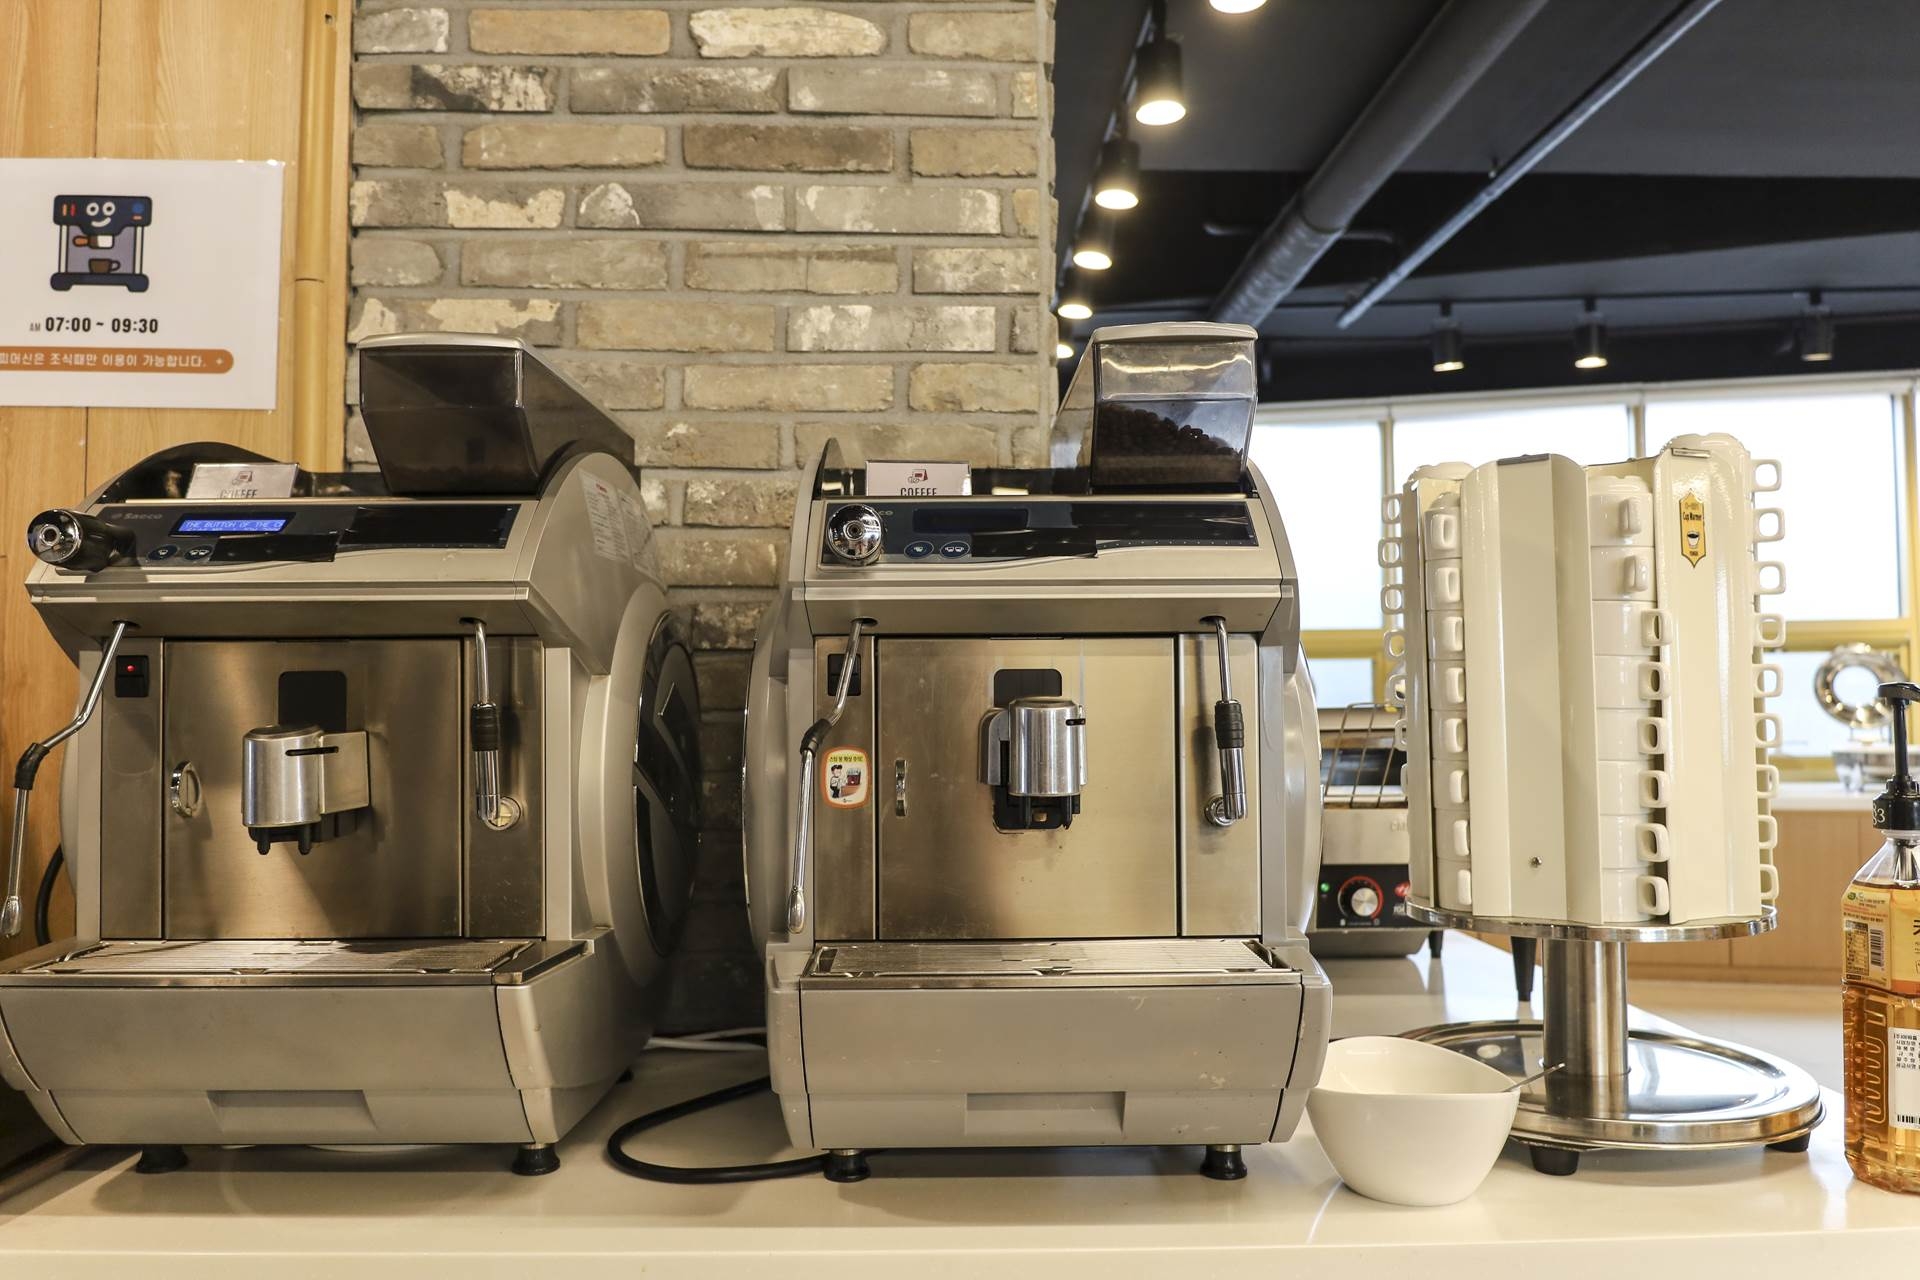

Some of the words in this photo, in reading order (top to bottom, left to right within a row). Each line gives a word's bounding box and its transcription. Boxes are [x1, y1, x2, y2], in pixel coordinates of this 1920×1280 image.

[45, 316, 91, 332] 07:00
[111, 318, 159, 333] 09:30
[102, 353, 137, 367] 이용이
[142, 354, 207, 368] 가능합니다.
[900, 487, 937, 496] COFFEE
